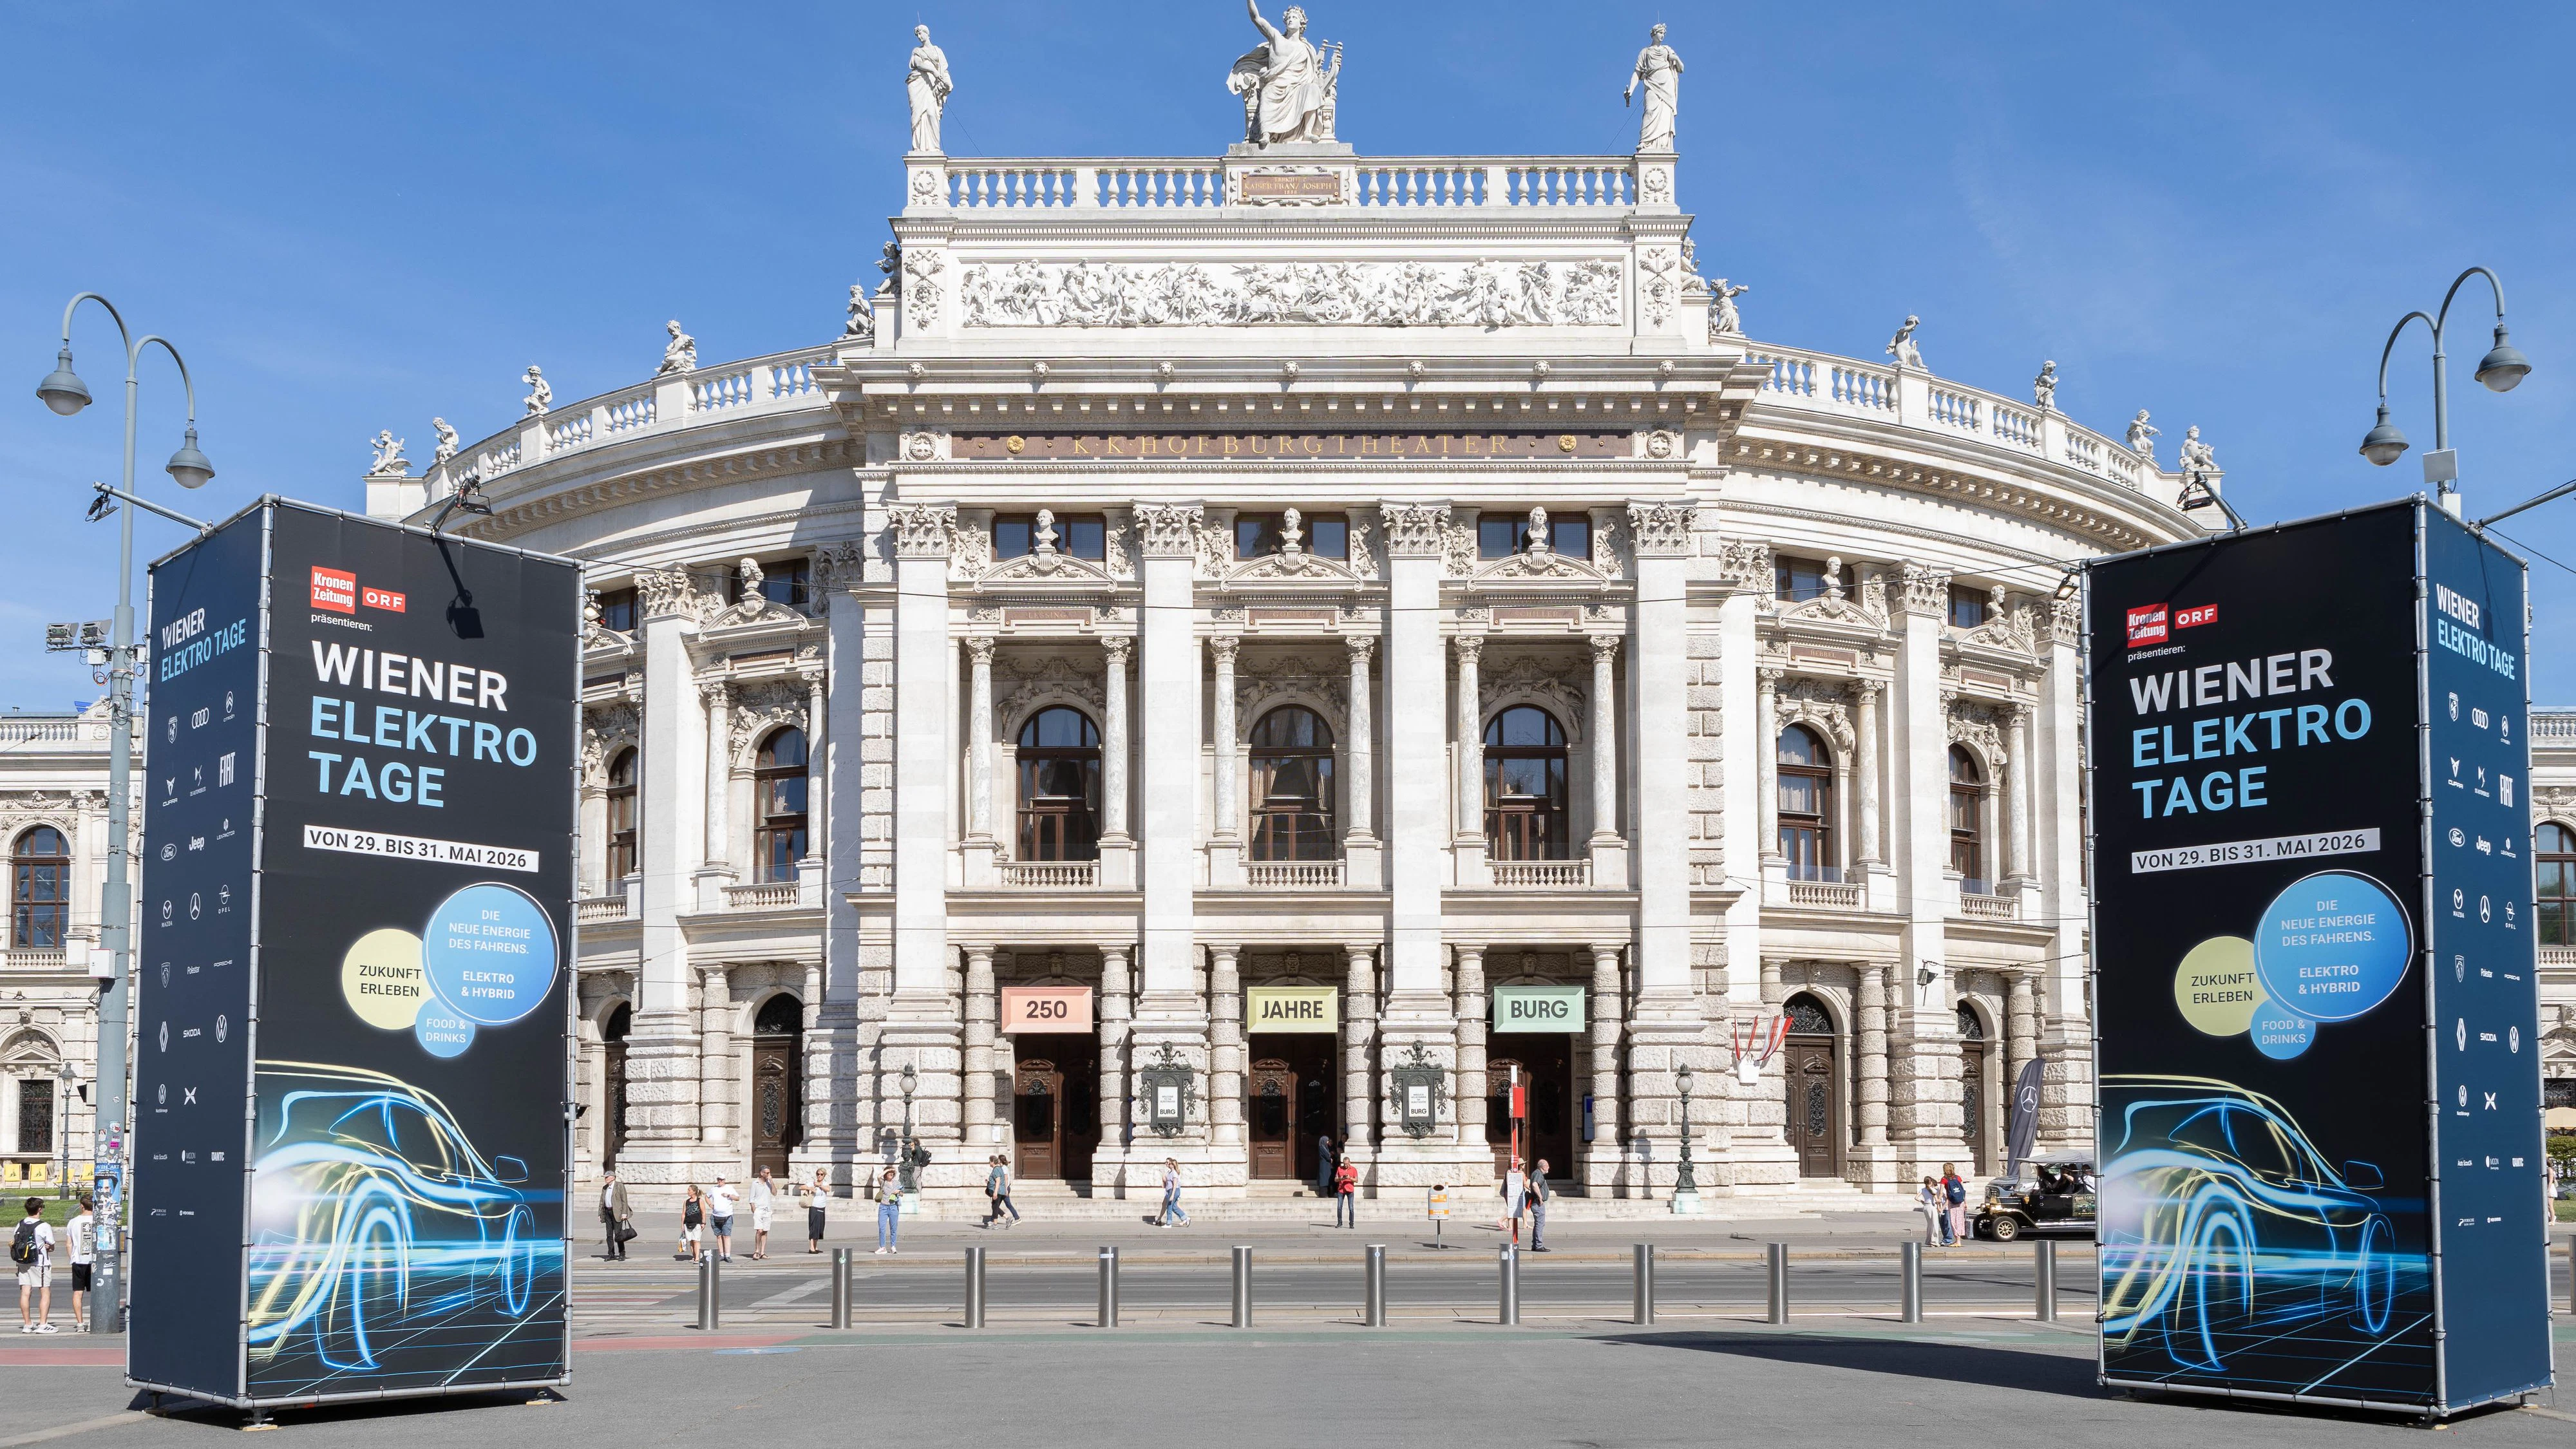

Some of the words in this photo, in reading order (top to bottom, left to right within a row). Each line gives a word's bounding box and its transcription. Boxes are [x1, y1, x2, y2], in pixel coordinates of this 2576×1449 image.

[314, 573, 354, 591] Kronen
[314, 587, 353, 607] Zeitung
[366, 592, 402, 608] ORF
[2436, 583, 2479, 630] WIENER
[311, 614, 372, 632] präsentieren:
[2129, 611, 2165, 627] Kronen
[2178, 608, 2214, 625] ORF
[162, 607, 205, 650] WIENER
[2129, 624, 2166, 640] Zeitung
[162, 637, 211, 682] ELEKTRO
[214, 618, 246, 656] TAGE
[2128, 645, 2186, 663] präsentieren:
[2438, 618, 2486, 665] ELEKTRO
[2488, 644, 2515, 680] TAGE
[312, 640, 507, 712] WIENER
[2130, 649, 2334, 715] WIENER
[312, 696, 537, 766] ELEKTRO
[2133, 698, 2371, 768] ELEKTRO
[220, 752, 236, 787] FIAT
[308, 751, 444, 807] TAGE
[2132, 766, 2268, 819] TAGE
[2499, 774, 2513, 808] FIAT
[163, 798, 178, 807] CUPRA
[189, 837, 204, 851] Jeep
[310, 829, 348, 848] VON
[354, 835, 380, 852] 29.
[386, 839, 414, 855] BIS
[419, 842, 443, 858] 31.
[450, 846, 481, 862] MAI
[487, 851, 526, 867] 2026
[2137, 853, 2173, 869] VON
[2179, 850, 2204, 866] 29.
[2210, 847, 2239, 862] BIS
[2244, 844, 2270, 859] 31.
[2277, 840, 2312, 857] MAI
[2318, 834, 2365, 852] 2026
[2476, 835, 2491, 855] Jeep
[2317, 900, 2338, 911] DIE
[482, 910, 500, 921] DIE
[2282, 918, 2315, 931] NEUE
[2319, 914, 2375, 928] ENERGIE
[449, 923, 479, 935] NEUE
[483, 925, 531, 939] ENERGIE
[2282, 935, 2307, 947] DES
[2311, 931, 2375, 945] FAHRENS.
[449, 938, 471, 950] DES
[475, 940, 529, 954] FAHRENS.
[187, 966, 200, 974] Polestar
[359, 965, 422, 980] ZUKUNFT
[463, 971, 515, 984] ELEKTRO
[2300, 965, 2359, 978] ELEKTRO
[2191, 972, 2254, 987] ZUKUNFT
[2298, 984, 2307, 994] &
[2311, 981, 2360, 994] HYBRID
[361, 983, 419, 997] ERLEBEN
[461, 987, 469, 997] &
[472, 987, 515, 999] HYBRID
[2193, 990, 2253, 1004] ERLEBEN
[1026, 1000, 1068, 1019] 250
[1262, 1000, 1323, 1019] JAHRE
[1511, 999, 1569, 1019] BURG
[426, 1018, 455, 1029] FOOD
[459, 1019, 466, 1030] &
[2262, 1020, 2294, 1030] FOOD
[2297, 1019, 2306, 1029] &
[426, 1032, 466, 1043] DRINKS
[2262, 1034, 2306, 1044] DRINKS
